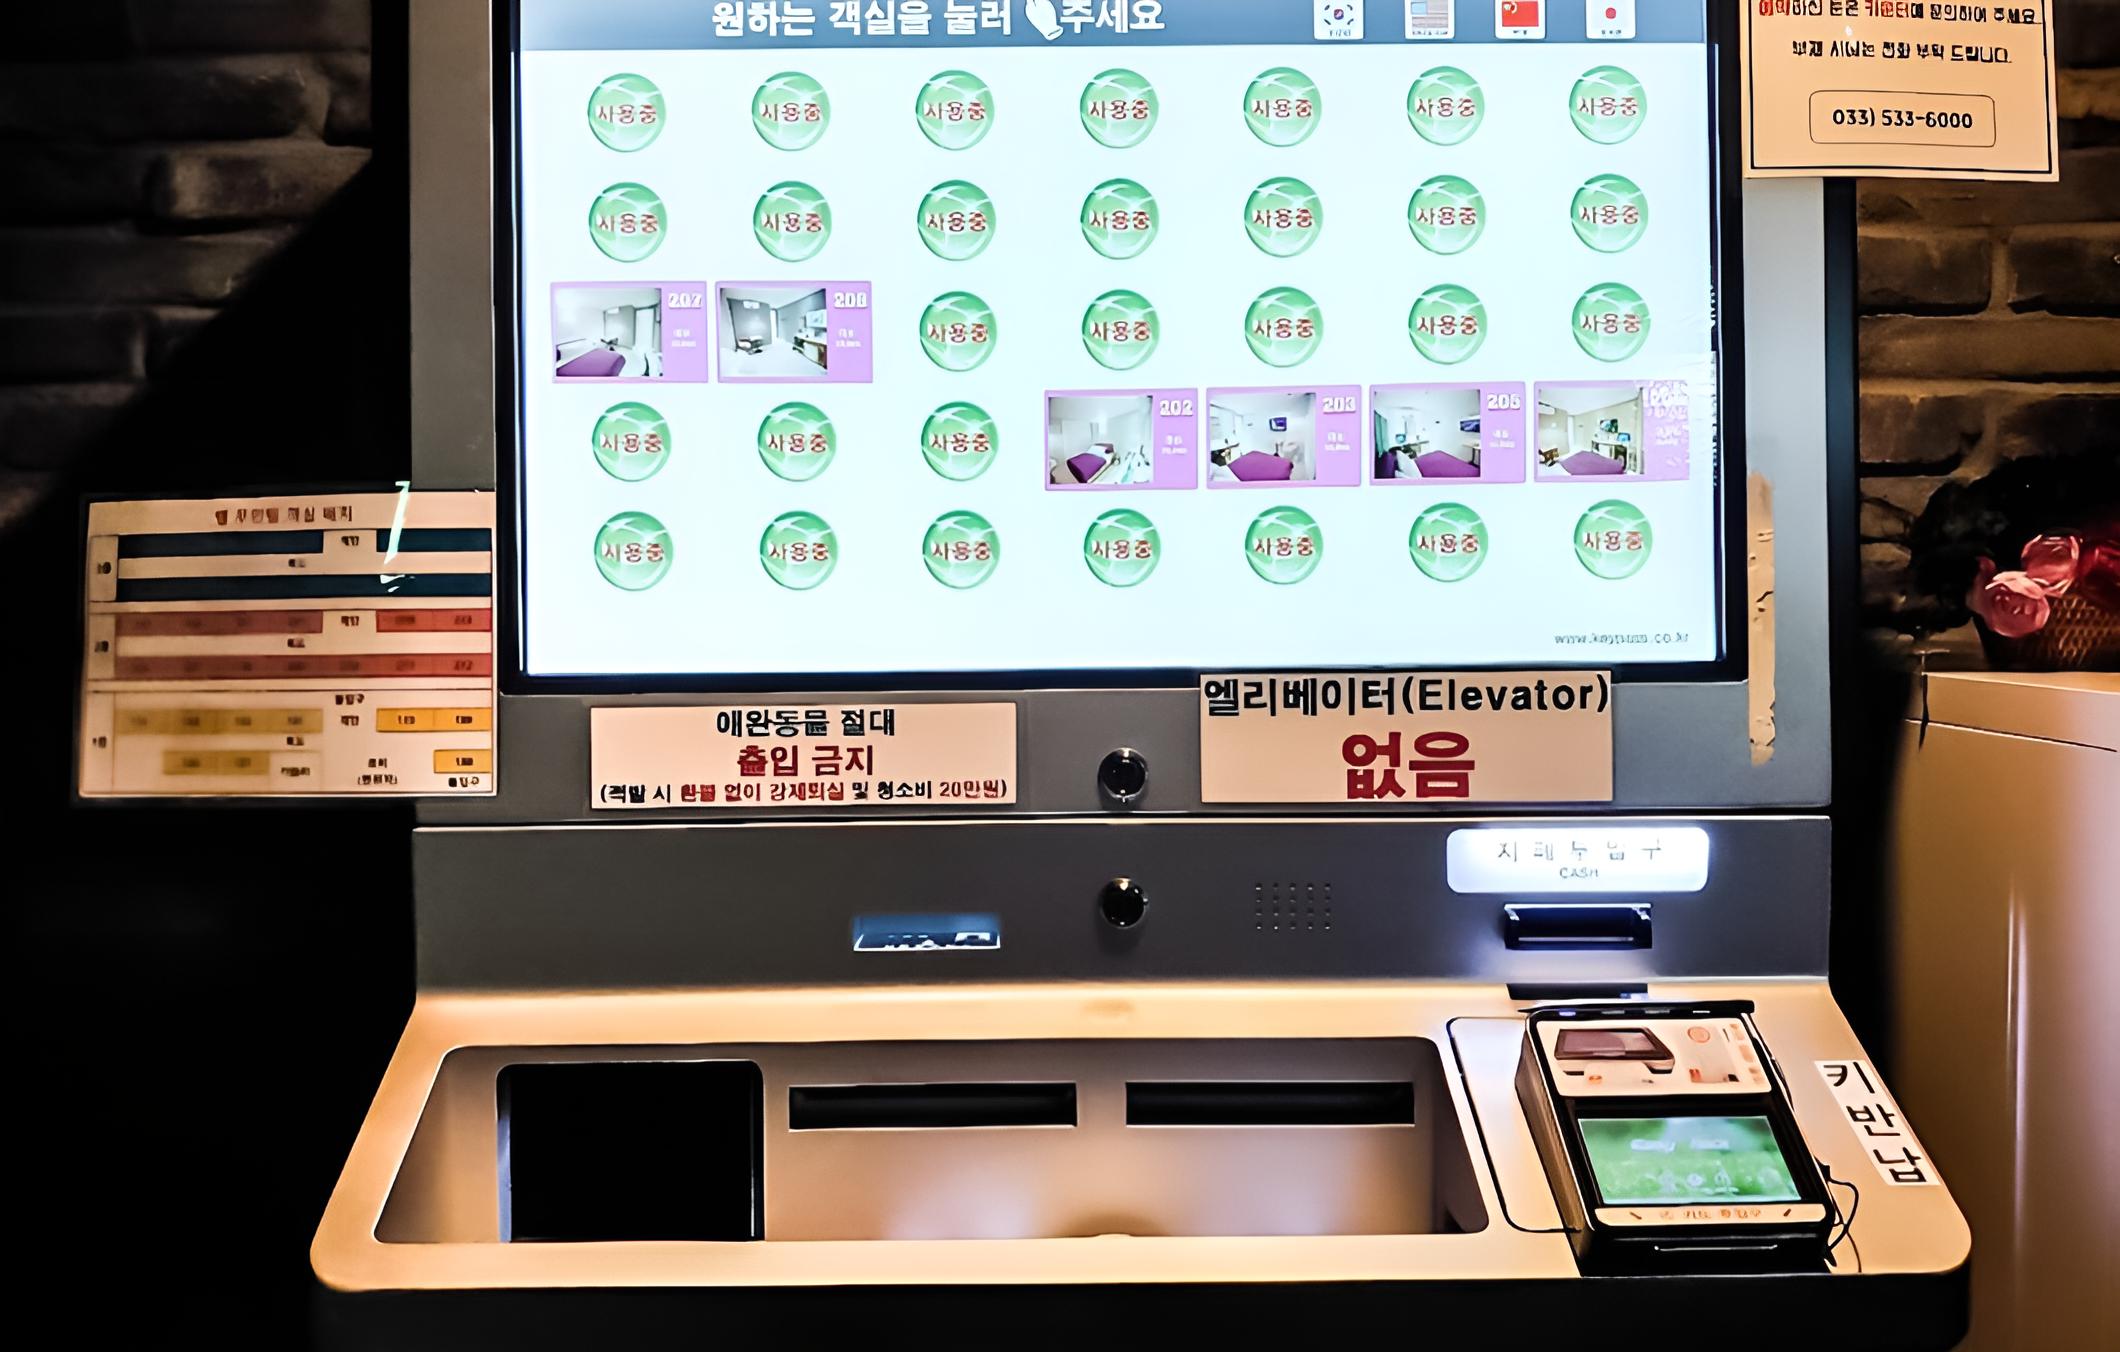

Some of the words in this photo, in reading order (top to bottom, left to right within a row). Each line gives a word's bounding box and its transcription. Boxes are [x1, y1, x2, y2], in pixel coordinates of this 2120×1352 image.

[712, 0, 815, 37] 원하는
[829, 0, 932, 36] 객실을
[944, 0, 1011, 36] 눌러
[1060, 0, 1166, 33] 주세요
[598, 104, 656, 125] 사용중
[762, 103, 820, 123] 사용중
[926, 102, 984, 121] 사용중
[1090, 99, 1147, 121] 사용중
[1253, 99, 1312, 119] 사용중
[1417, 98, 1473, 118] 사용중
[1578, 97, 1637, 117] 사용중
[1832, 108, 1876, 127] 033)
[1881, 109, 1974, 129] 533-6000
[598, 214, 657, 235] 사용중
[764, 213, 821, 233] 사용중
[927, 212, 985, 232] 사용중
[1092, 210, 1149, 231] 사용중
[1254, 208, 1313, 229] 사용중
[1418, 207, 1475, 226] 사용중
[1581, 207, 1637, 226] 사용중
[929, 323, 987, 344] 사용중
[1092, 321, 1148, 342] 사용중
[1256, 318, 1312, 340] 사용중
[1418, 316, 1476, 336] 사용중
[1583, 315, 1639, 335] 사용중
[602, 433, 661, 454] 사용중
[769, 433, 826, 454] 사용중
[932, 433, 988, 453] 사용중
[1094, 540, 1150, 561] 사용중
[1255, 537, 1313, 557] 사용중
[1419, 535, 1477, 554] 사용중
[1584, 531, 1641, 551] 사용중
[605, 543, 662, 564] 사용중
[770, 543, 827, 563] 사용중
[933, 542, 989, 562] 사용중
[1204, 674, 1610, 716] 엘리베이터(Elevator)
[716, 708, 830, 737] 애완동물
[840, 708, 896, 737] 절대
[736, 745, 799, 777] 출입
[811, 745, 874, 777] 금지
[1342, 731, 1477, 800] 없음
[652, 784, 672, 804] 시
[724, 783, 762, 803] 없이
[851, 781, 870, 801] 및
[877, 780, 933, 802] 청소비
[939, 778, 1008, 799] 20만원)
